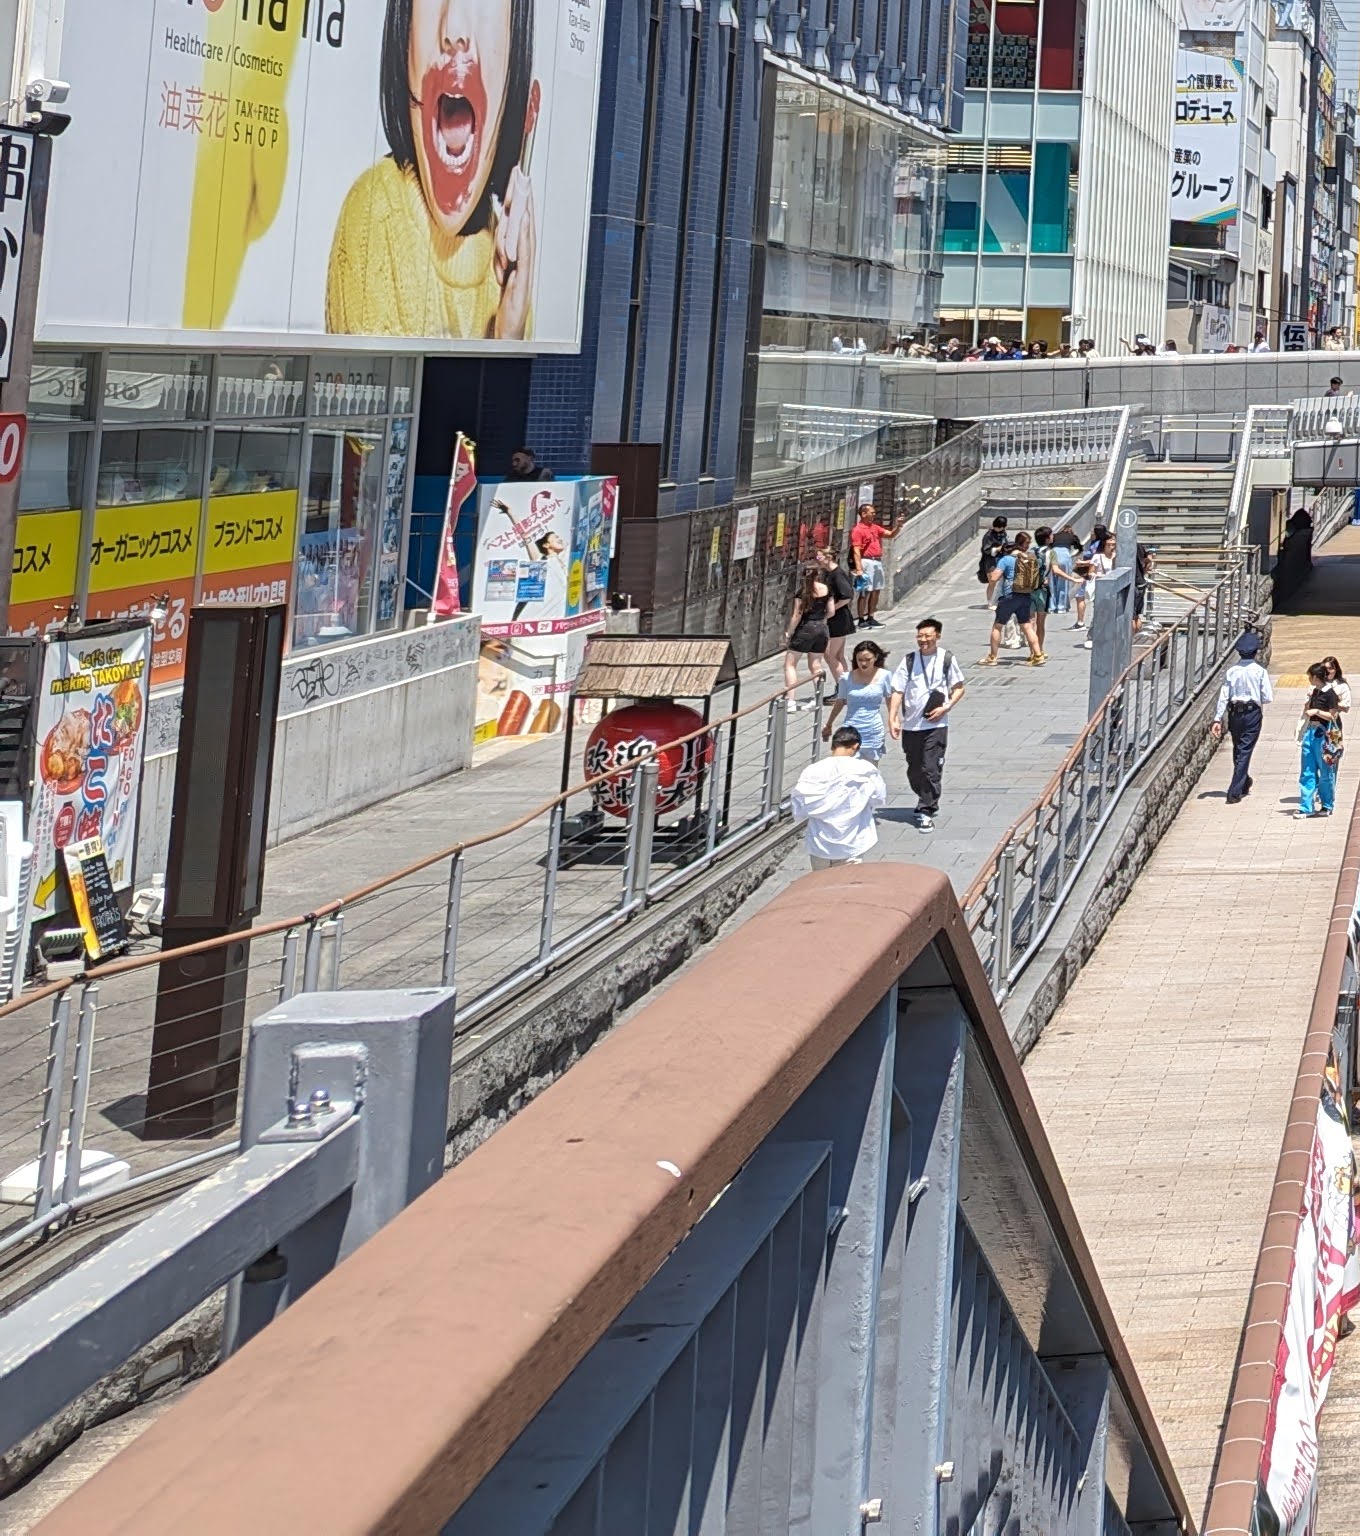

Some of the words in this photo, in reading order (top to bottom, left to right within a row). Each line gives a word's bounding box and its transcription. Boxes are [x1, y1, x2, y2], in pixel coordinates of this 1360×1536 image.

[164, 26, 225, 63] Healthcare
[233, 45, 284, 78] Cosmetics
[158, 80, 228, 139] 油菜花
[233, 120, 279, 150] SHOP
[90, 526, 194, 566] オーガニックコスメ
[213, 515, 284, 549] ブランドコスメ
